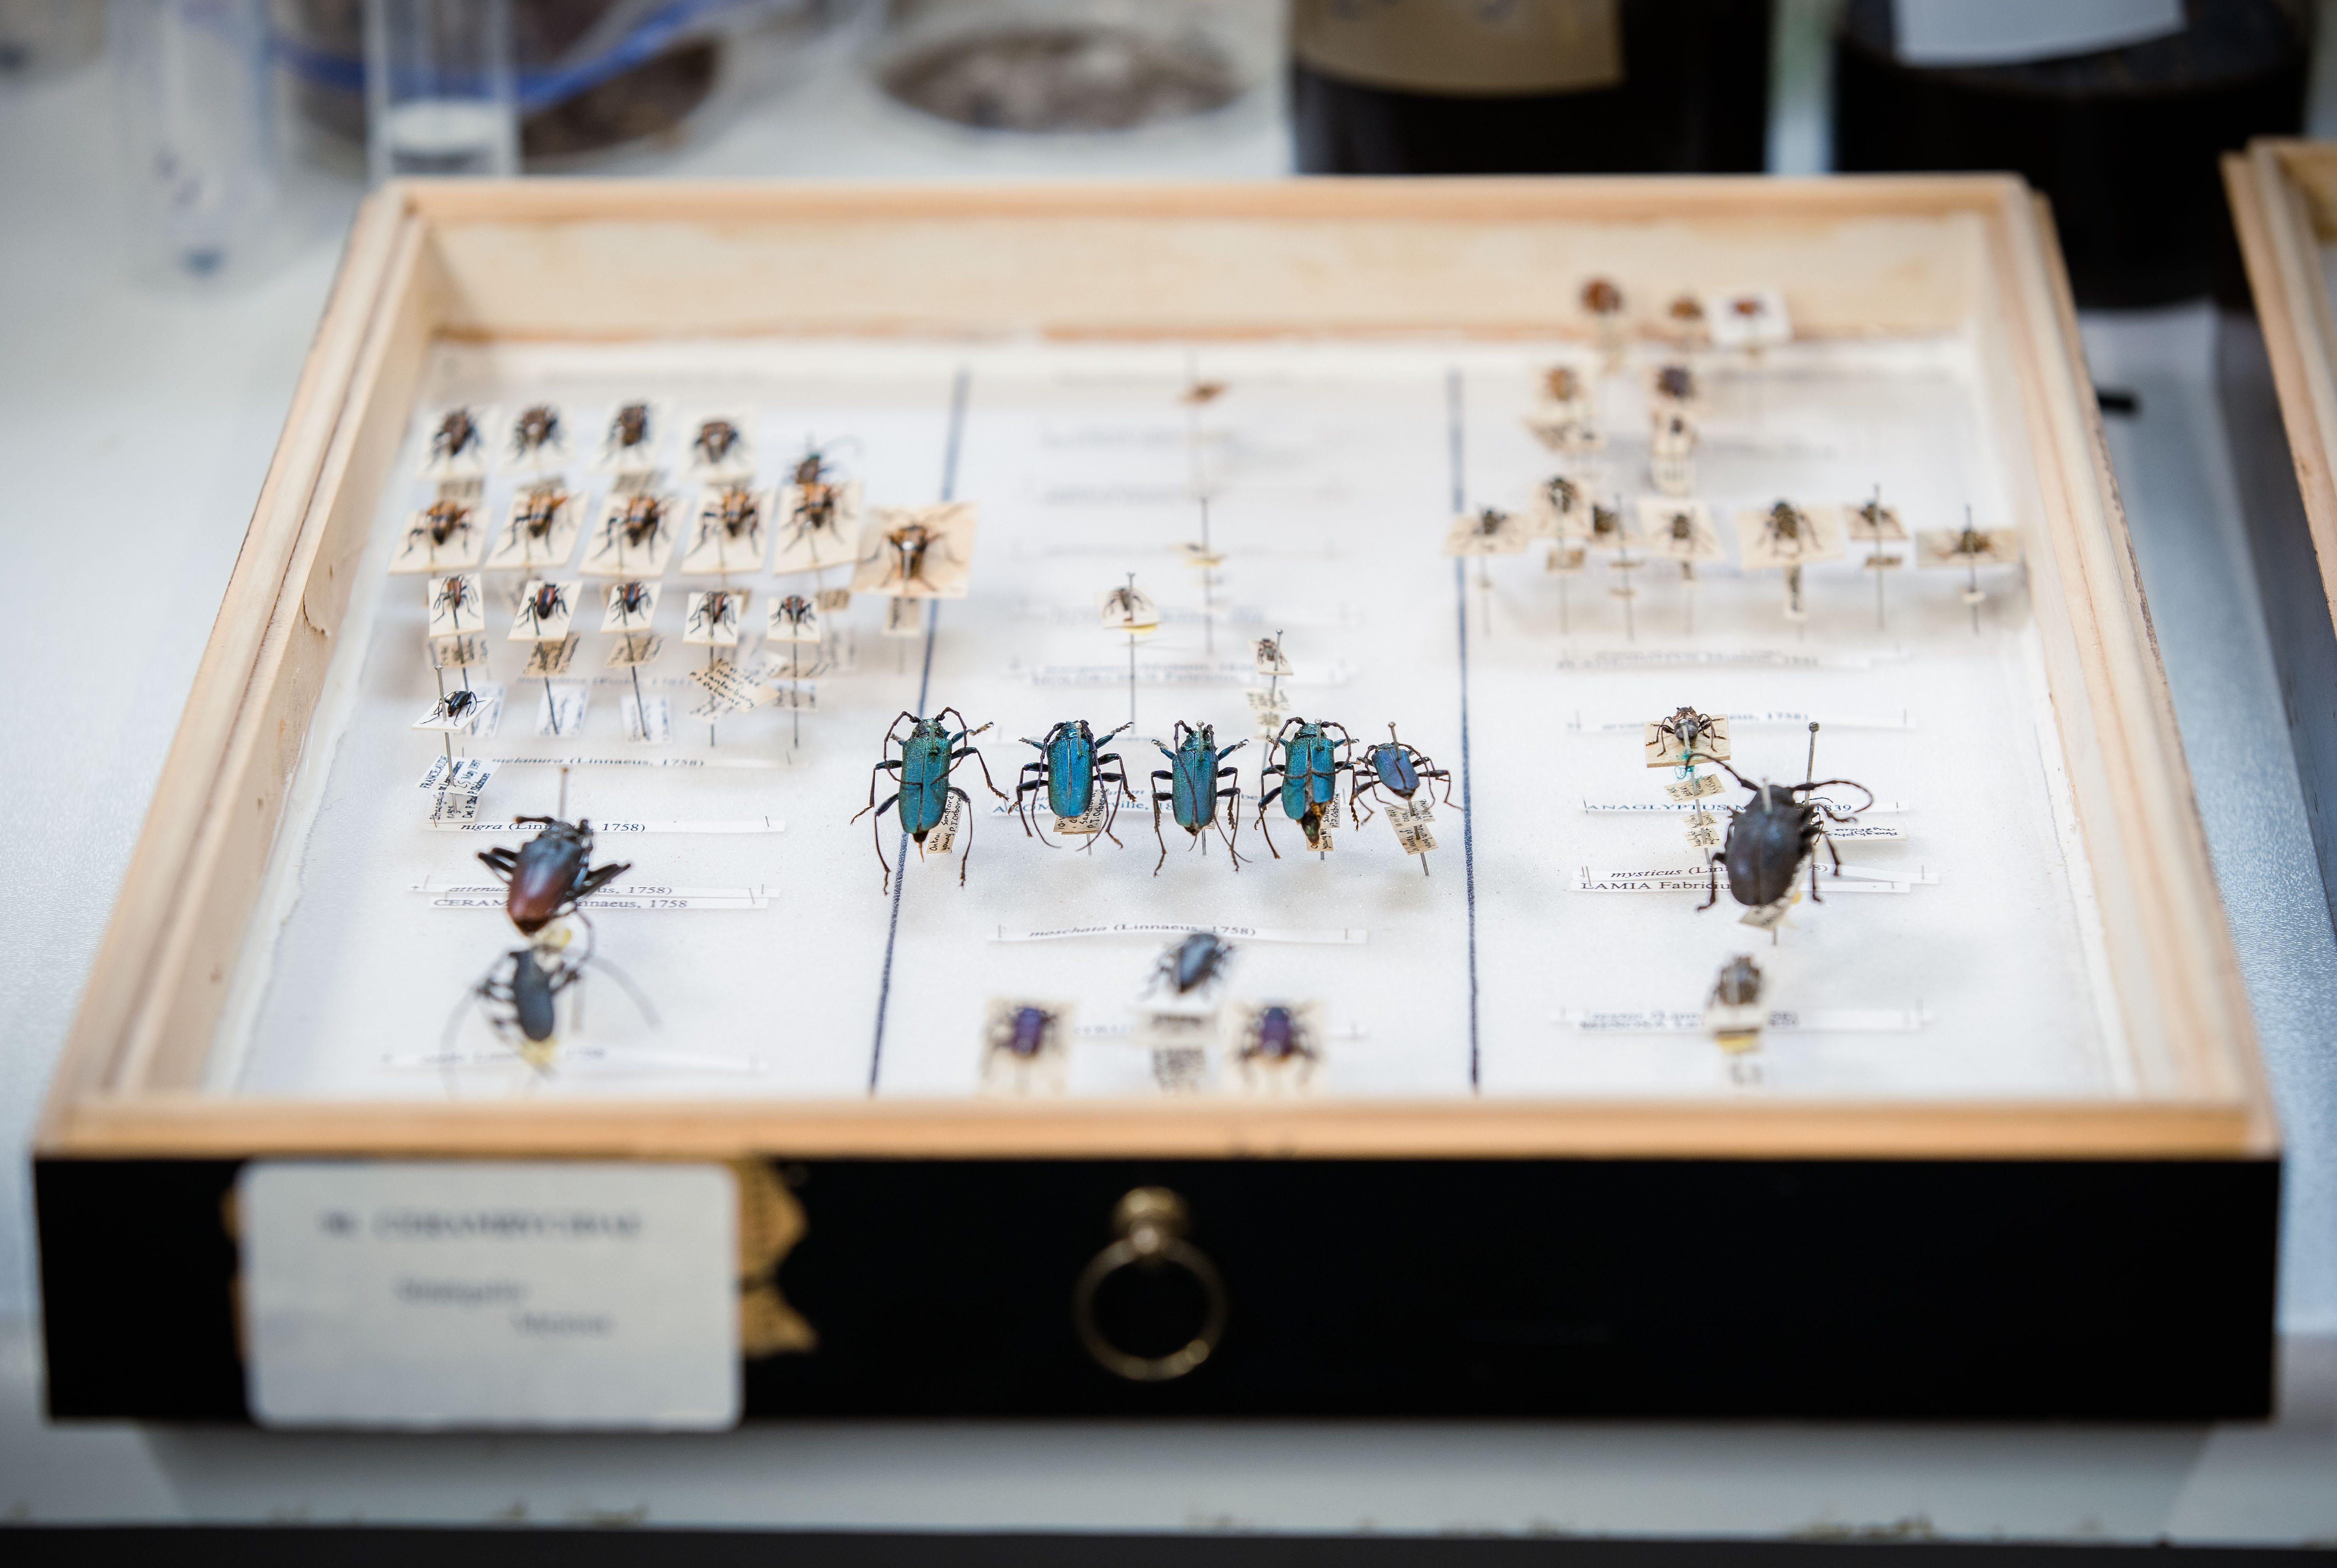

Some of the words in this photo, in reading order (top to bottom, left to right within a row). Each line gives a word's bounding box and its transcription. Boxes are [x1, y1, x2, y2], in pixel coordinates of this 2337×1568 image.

[993, 804, 1050, 812] AROM
[949, 798, 962, 832] P.J.Osborn
[602, 824, 646, 832] 1758)
[1611, 868, 1683, 879] mysticus
[1659, 881, 1731, 890] Fabriciu
[628, 887, 672, 895] 1758)
[1029, 925, 1107, 937] moschata
[1114, 923, 1202, 933] (Linnaeus,
[1211, 925, 1256, 937] 1758)
